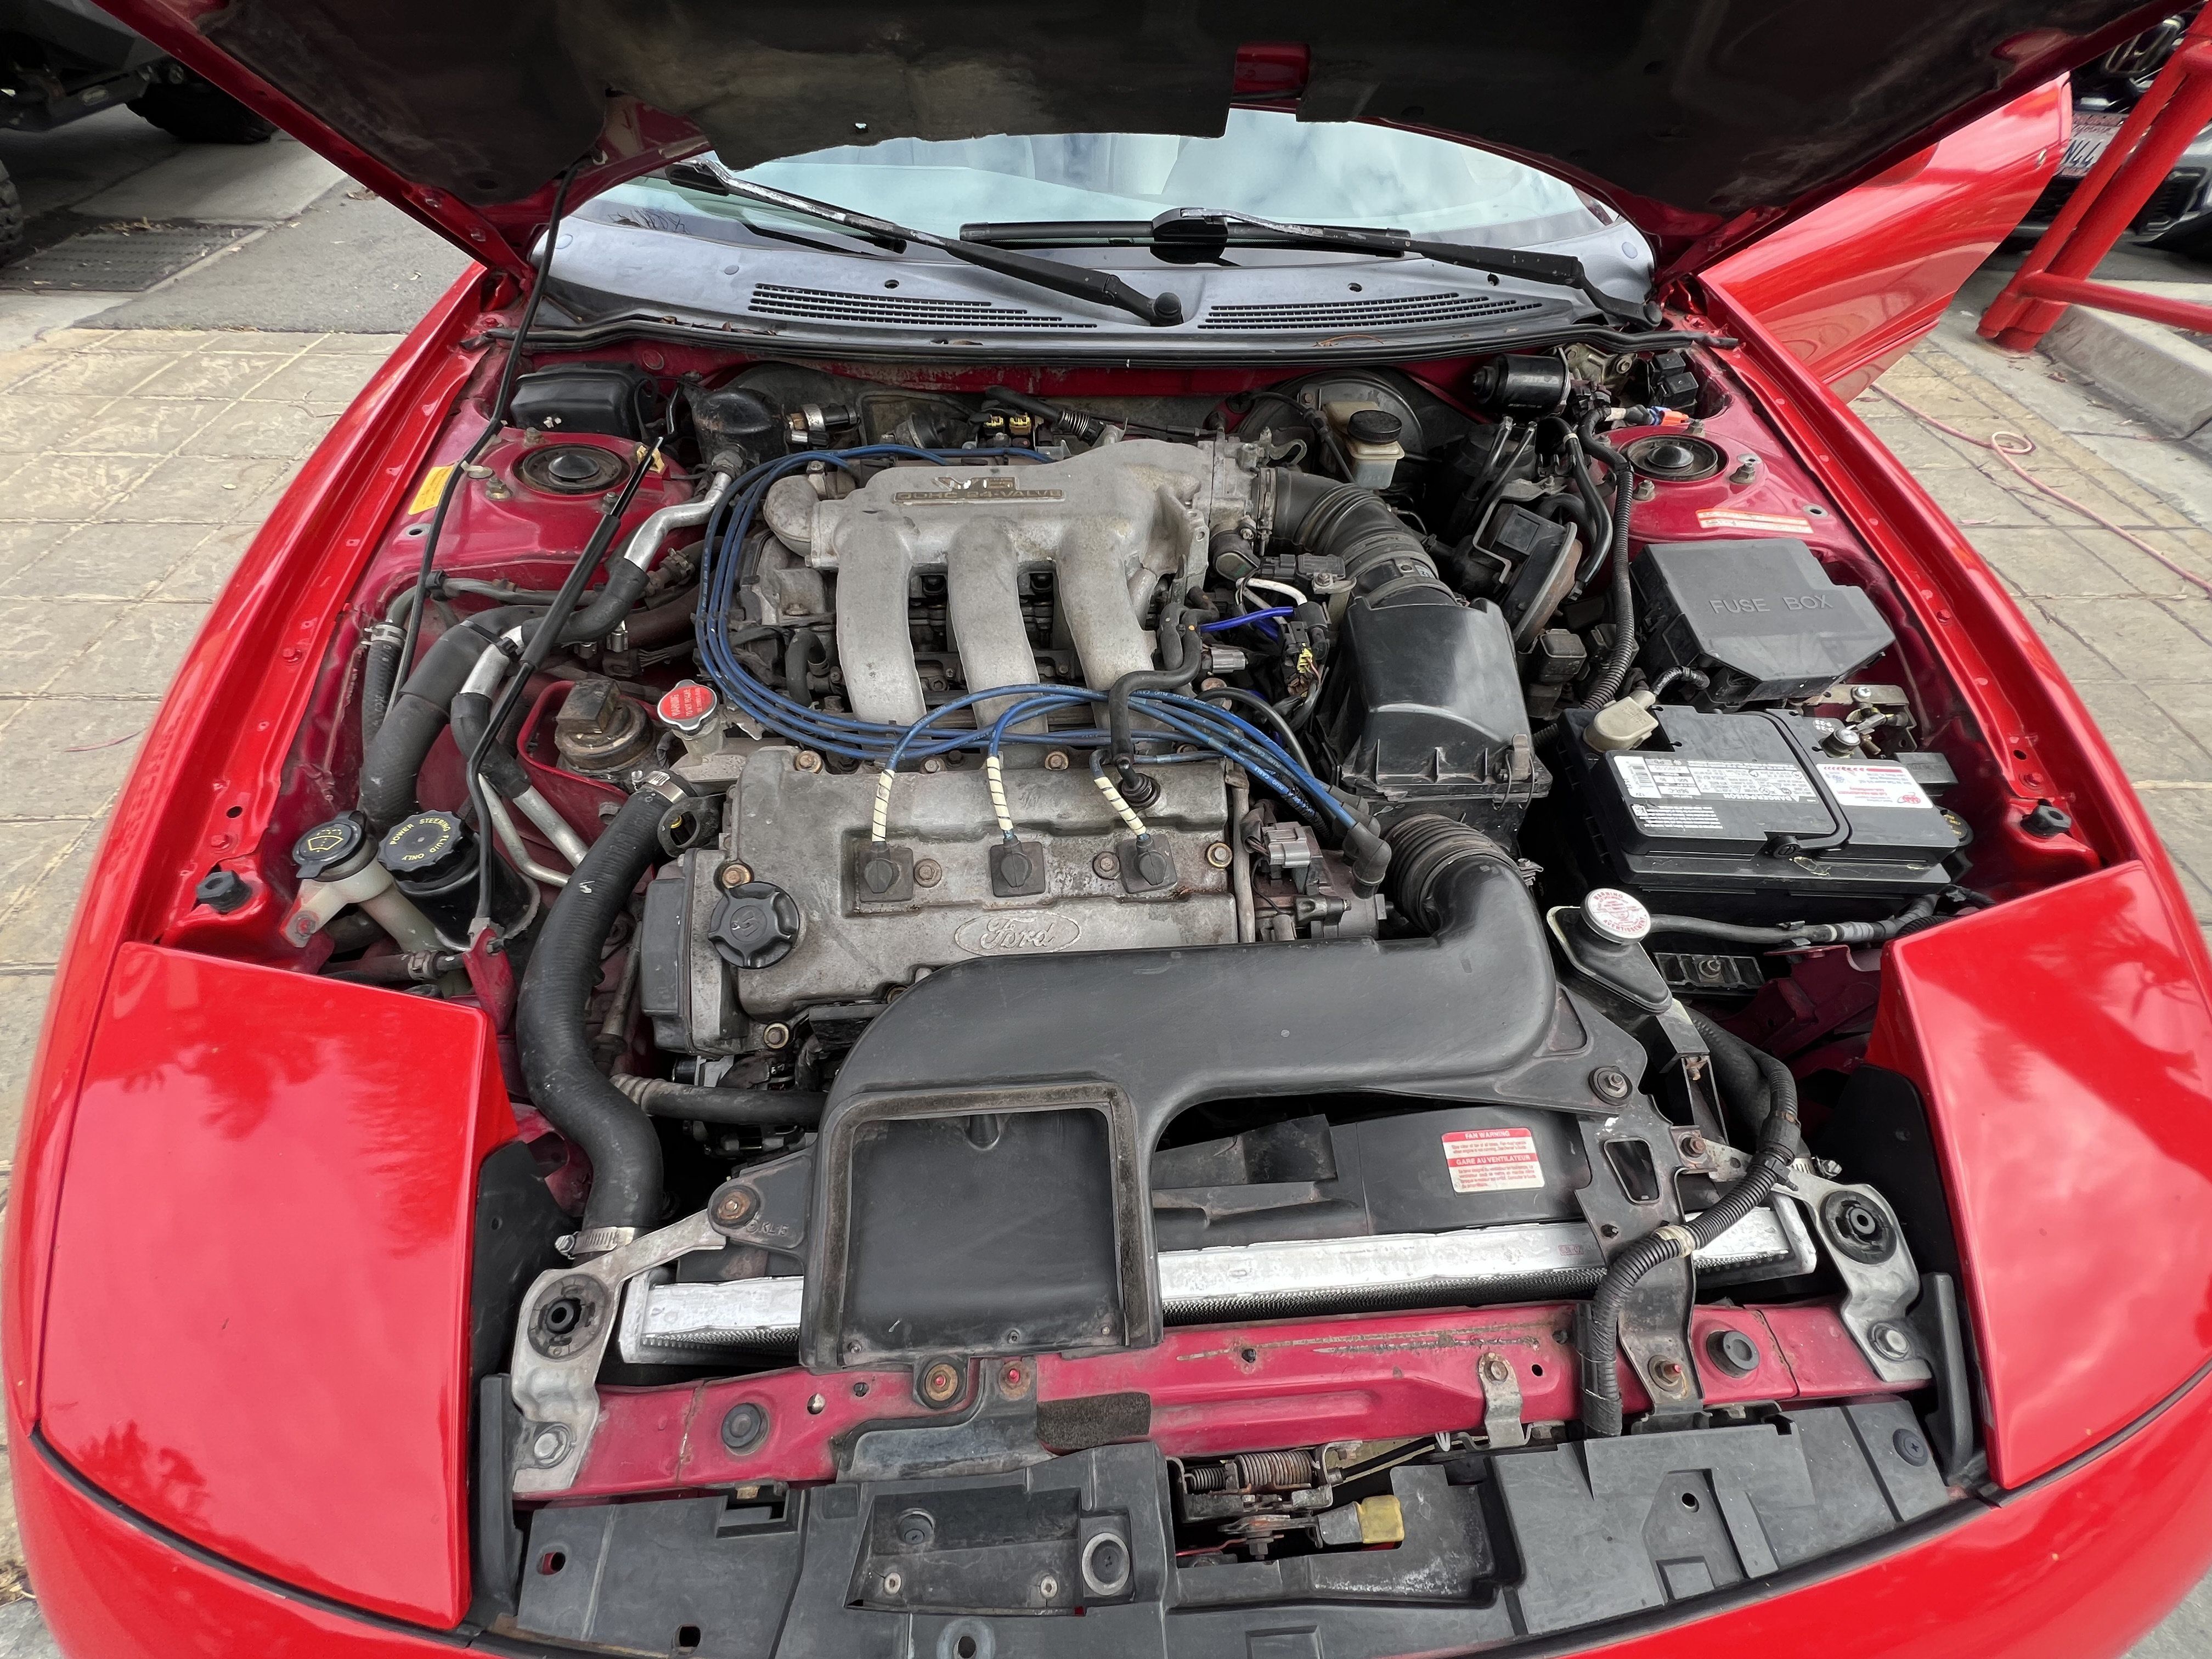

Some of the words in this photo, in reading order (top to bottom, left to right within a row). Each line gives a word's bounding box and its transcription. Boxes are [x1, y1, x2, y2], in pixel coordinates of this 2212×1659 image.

[1709, 598, 1770, 614] FUSE
[1782, 595, 1833, 610] BOX
[670, 694, 681, 716] WARNING
[1254, 766, 1269, 780] CABLE
[1271, 780, 1285, 792] PLUG
[419, 818, 451, 832] STEERING
[389, 823, 414, 845] POWER
[429, 834, 450, 853] FLUID
[1593, 891, 1623, 900] WARNING
[1603, 917, 1646, 932] AVERTISSEMENT
[980, 917, 1062, 950] Ford
[1486, 1154, 1531, 1163] VENTILATEUR
